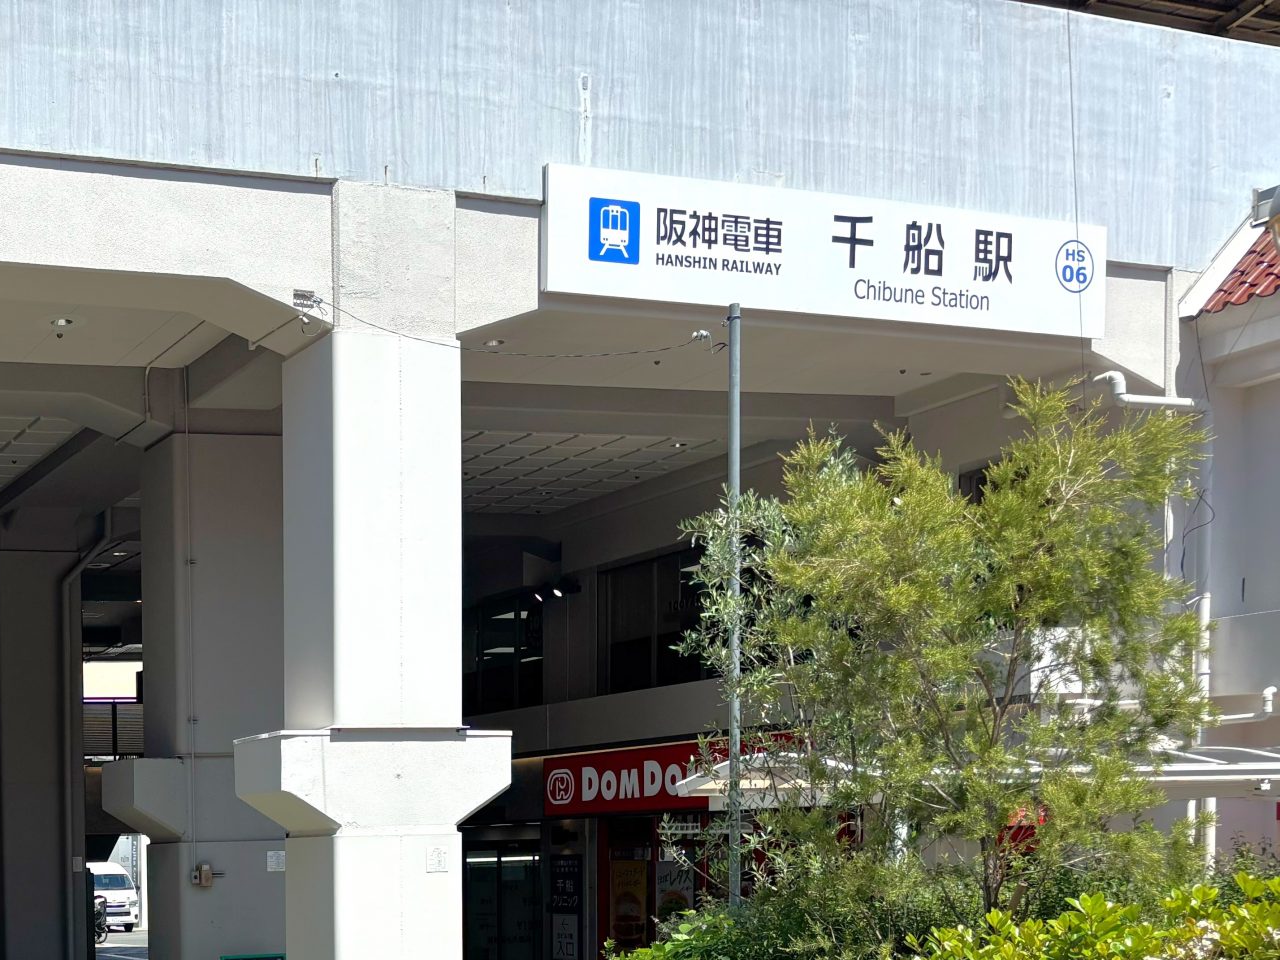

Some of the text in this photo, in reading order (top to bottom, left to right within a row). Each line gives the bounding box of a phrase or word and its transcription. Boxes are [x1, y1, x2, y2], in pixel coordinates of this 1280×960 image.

[656, 207, 783, 255] 阪神電車
[832, 215, 1013, 284] 千船駅
[1065, 248, 1086, 263] HS
[656, 252, 782, 275] HANSHIN RAILWAY
[1061, 264, 1088, 284] 06
[854, 279, 990, 311] Chibune Station
[556, 941, 575, 957] 入口
